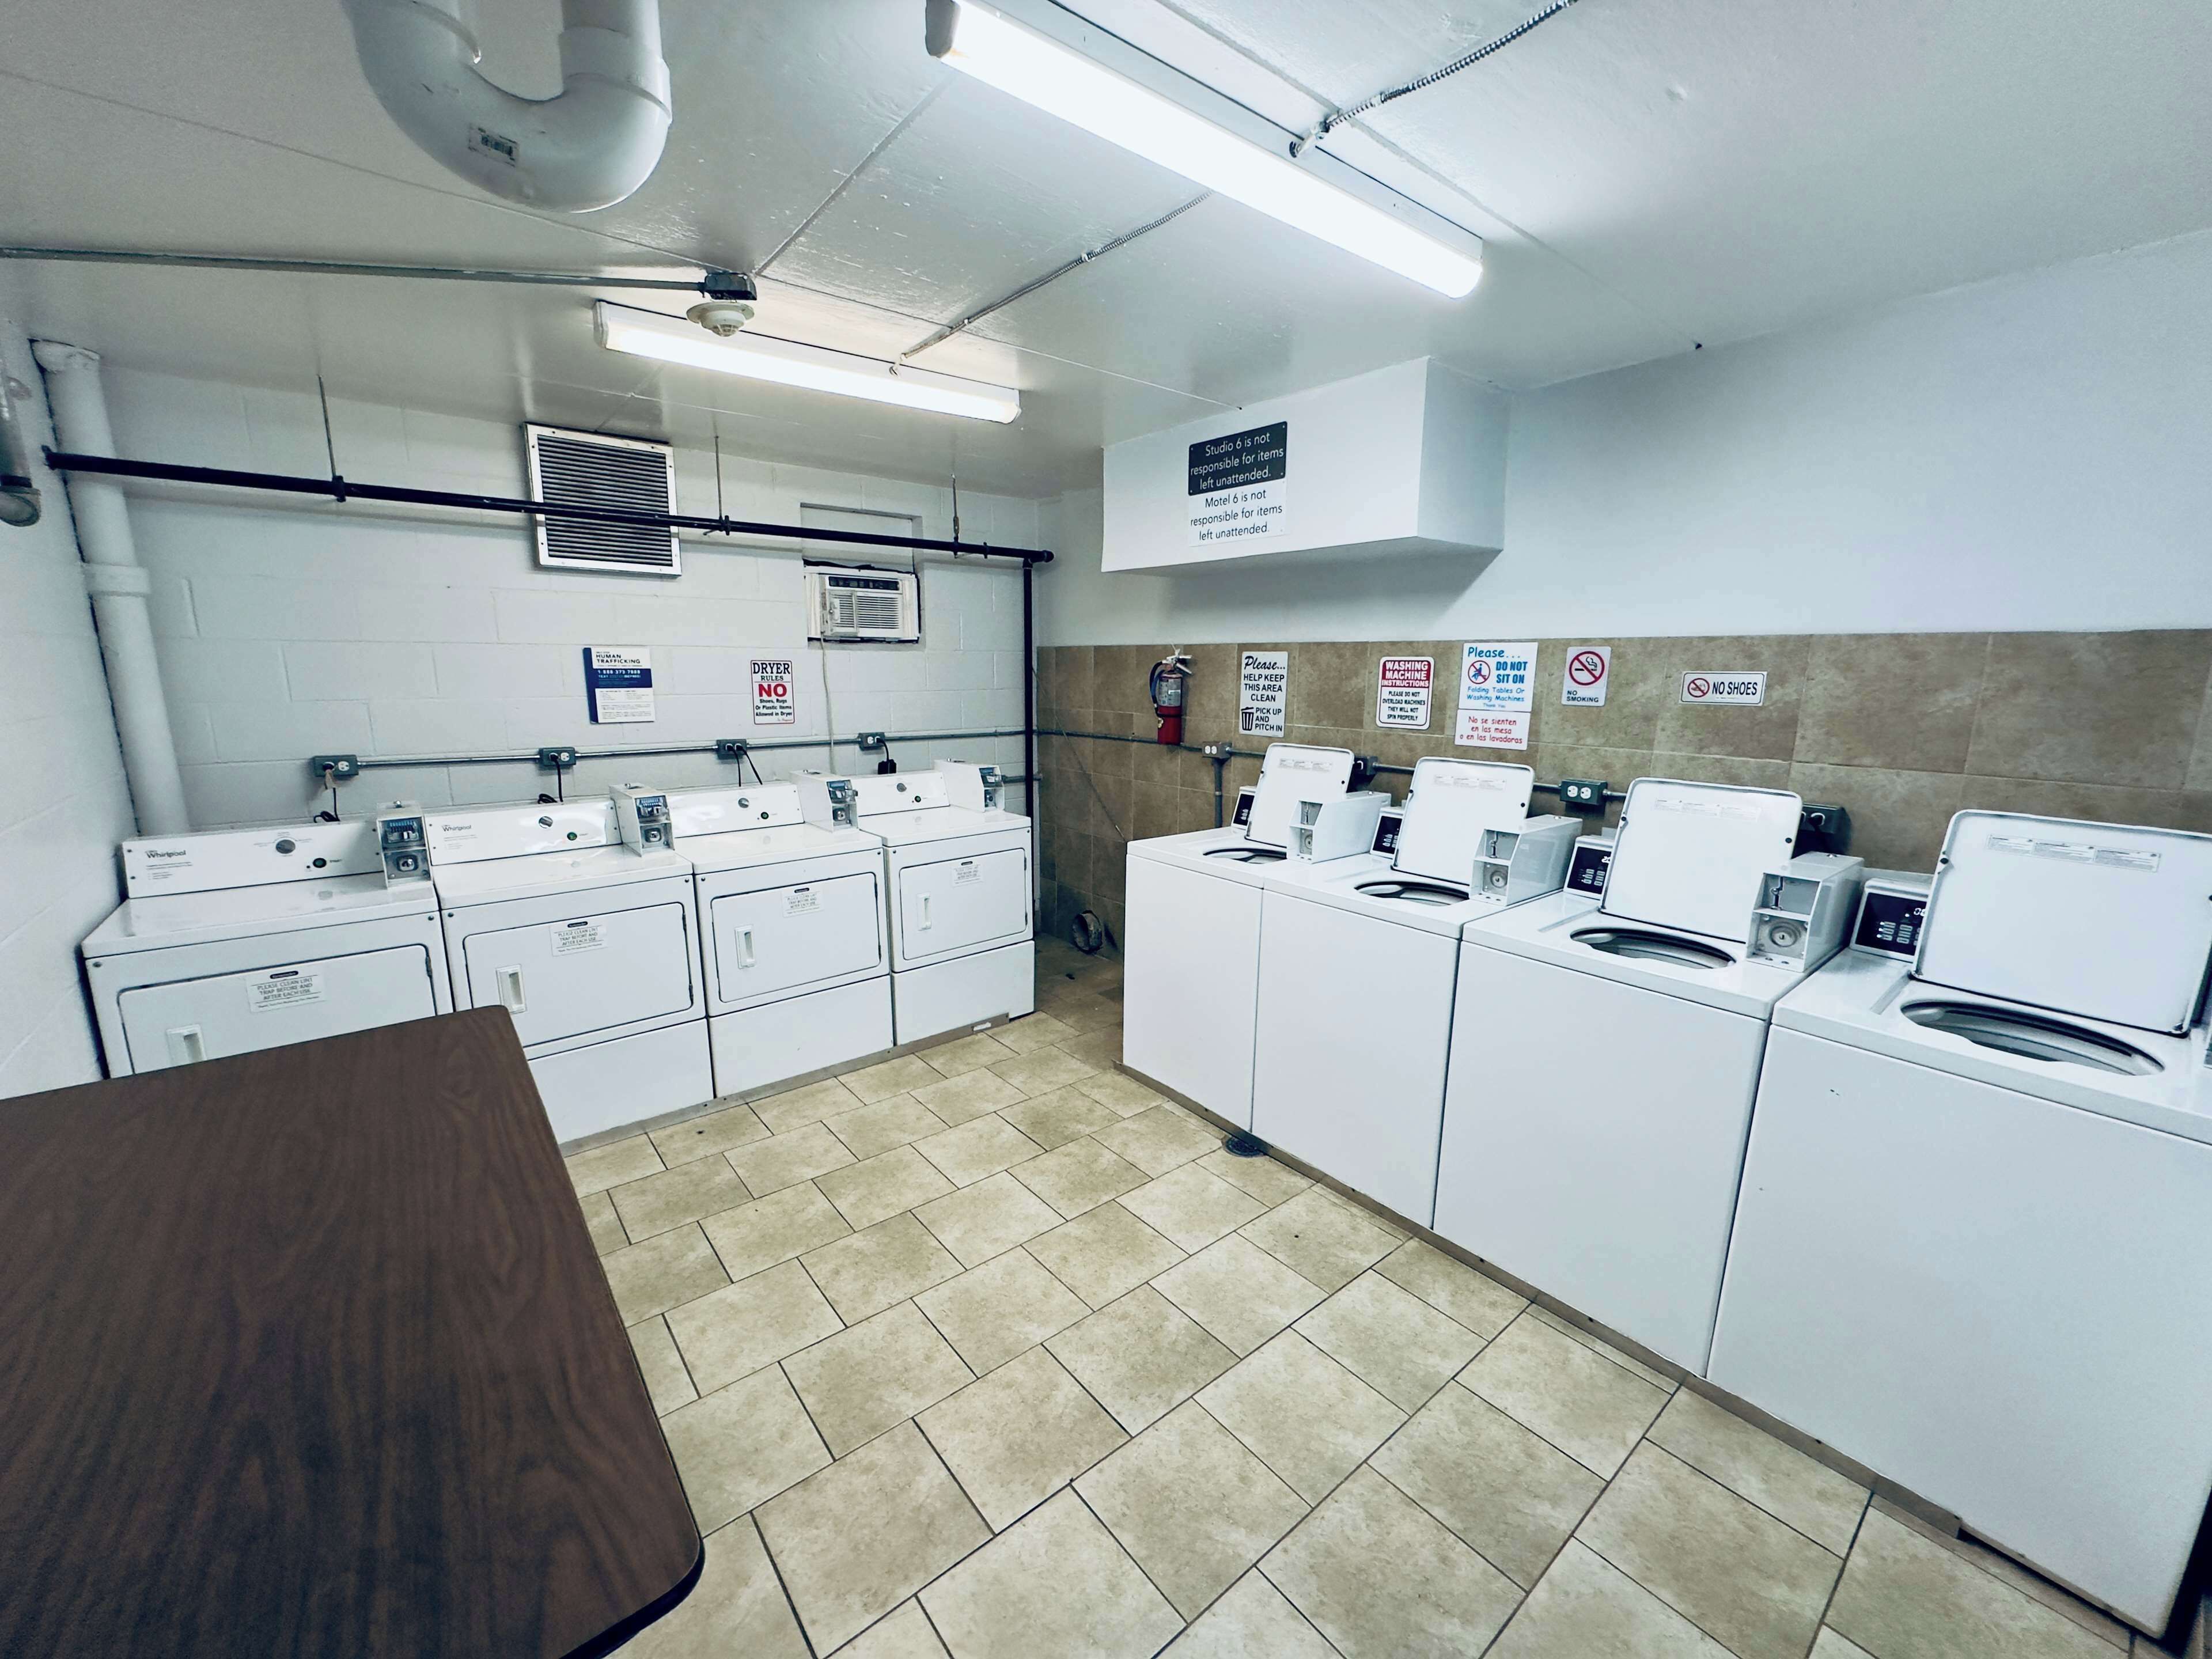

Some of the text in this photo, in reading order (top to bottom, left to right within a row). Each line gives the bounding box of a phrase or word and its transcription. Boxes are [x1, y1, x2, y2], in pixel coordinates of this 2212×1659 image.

[1205, 433, 1270, 456] Studio 6 is not
[1191, 448, 1283, 476] responsible for items
[1200, 465, 1271, 490] left unattended.
[1205, 490, 1266, 508] Motel 6 is not
[1191, 505, 1282, 527] responsible for items
[1199, 521, 1270, 540] left unattended.
[752, 662, 790, 675] DRYER
[1244, 656, 1285, 670] Please...
[1385, 661, 1428, 671] WASHING
[1496, 661, 1528, 671] DO NOT
[1244, 673, 1285, 682] HELP KEEP
[1385, 671, 1427, 680] MACHINE
[1496, 674, 1525, 684] SIT ON
[758, 683, 787, 698] NO
[1244, 683, 1282, 692] THIS AREA
[1712, 681, 1758, 696] NO SHOES
[1251, 694, 1276, 702] CLEAN
[1489, 734, 1522, 744] lavadoras
[145, 850, 186, 858] Whirlpool
